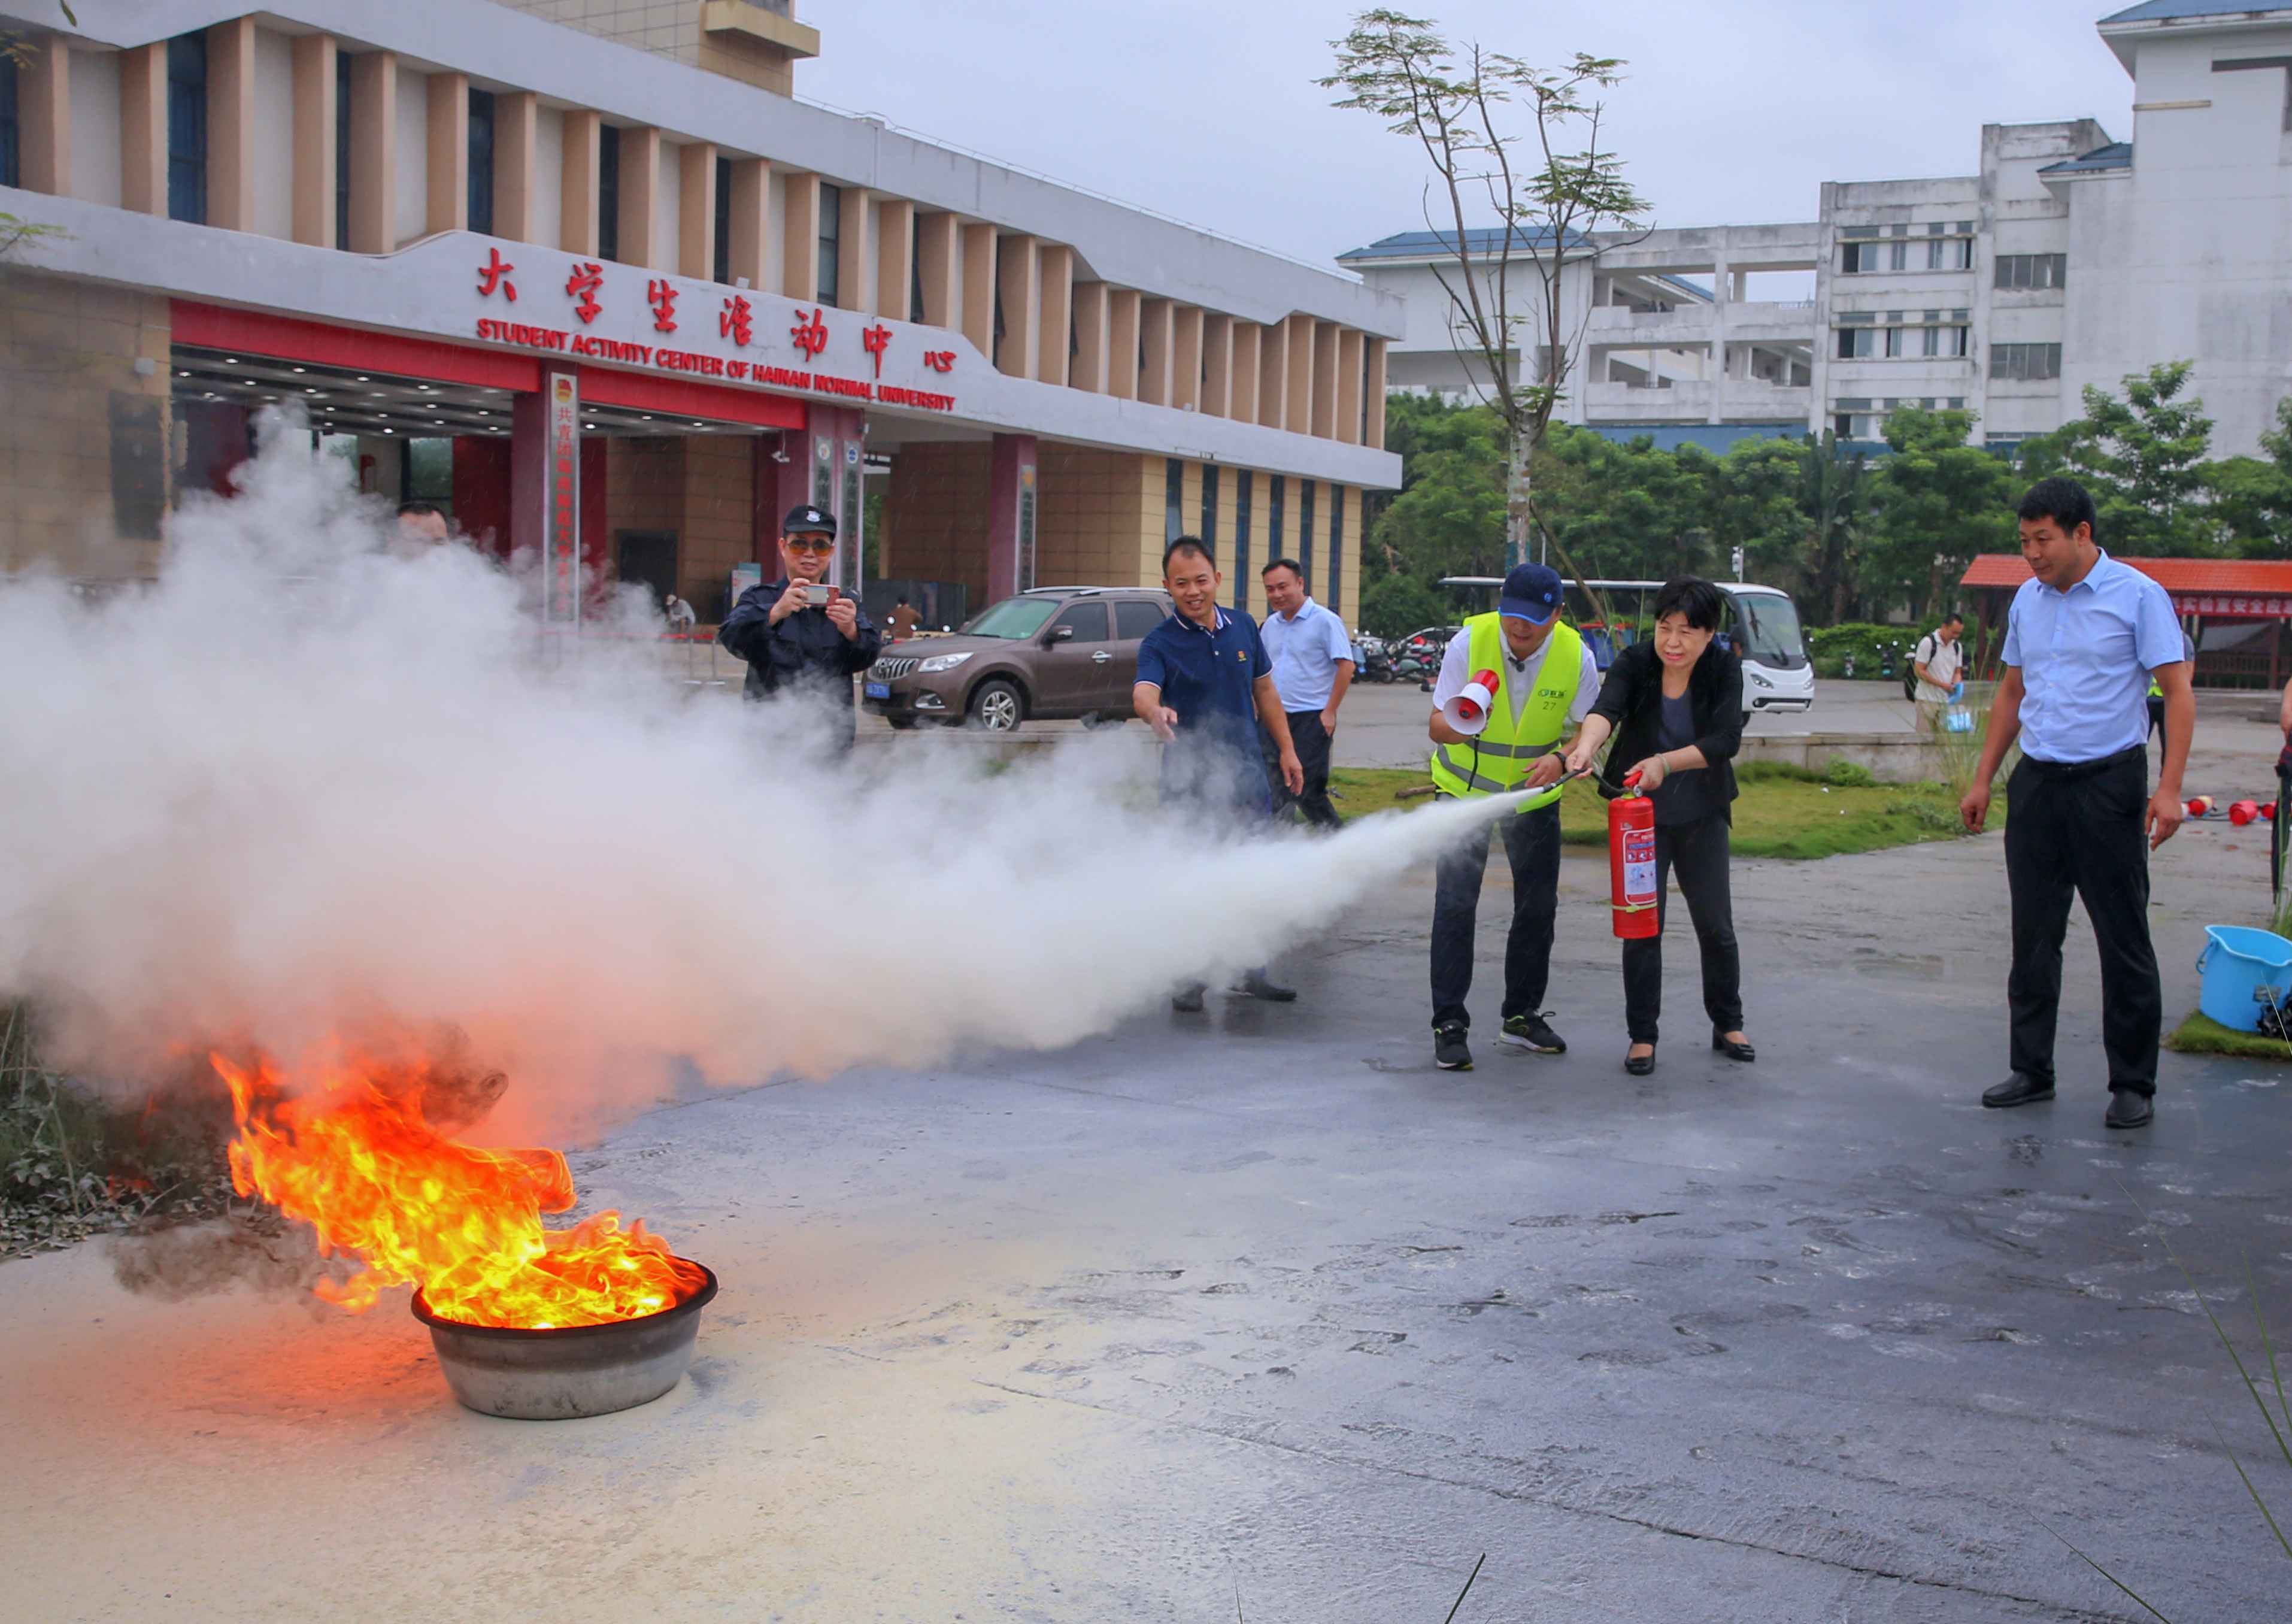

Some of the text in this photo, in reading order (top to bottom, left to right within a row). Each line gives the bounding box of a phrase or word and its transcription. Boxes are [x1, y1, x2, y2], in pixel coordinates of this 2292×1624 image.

[478, 248, 957, 378] 大学生活动中心
[477, 318, 957, 411] STUDENT ACTIVITY CENTER OF HAINAN NORMAL UNIVERSITY
[1542, 701, 1557, 711] 27
